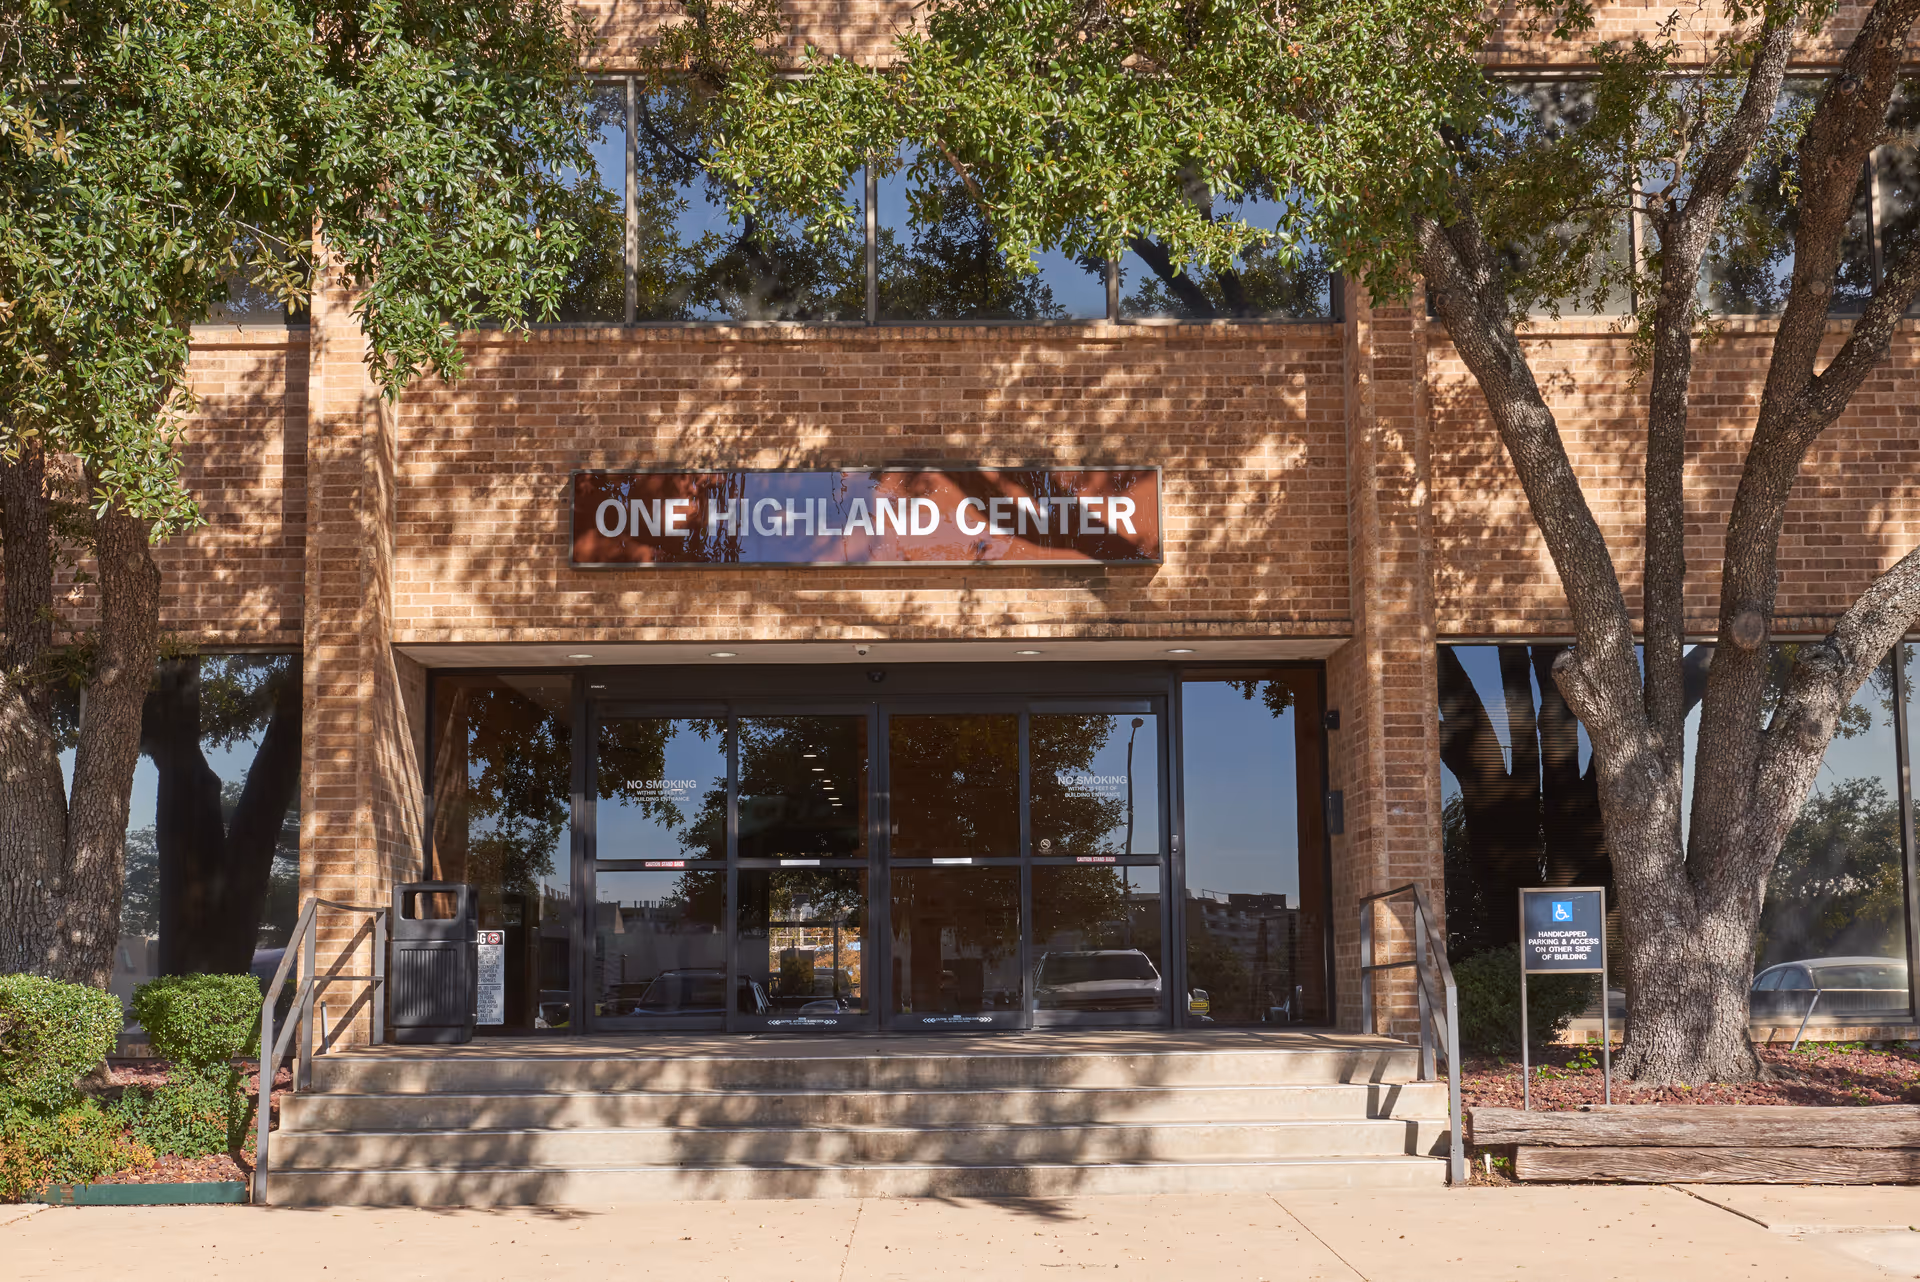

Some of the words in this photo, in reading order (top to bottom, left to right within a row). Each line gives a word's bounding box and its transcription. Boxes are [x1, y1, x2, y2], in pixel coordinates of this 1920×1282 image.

[596, 498, 690, 538] ONE
[706, 497, 940, 537] HIGHLAND
[957, 496, 1137, 537] CENTER
[626, 780, 643, 789] NO
[645, 780, 697, 789] SMOKING
[1057, 776, 1074, 785] NO
[1076, 775, 1128, 785] SMOKING
[1538, 930, 1588, 938] HANDICAPPED
[1548, 945, 1573, 953] OTHER
[1575, 945, 1592, 953] SIDE
